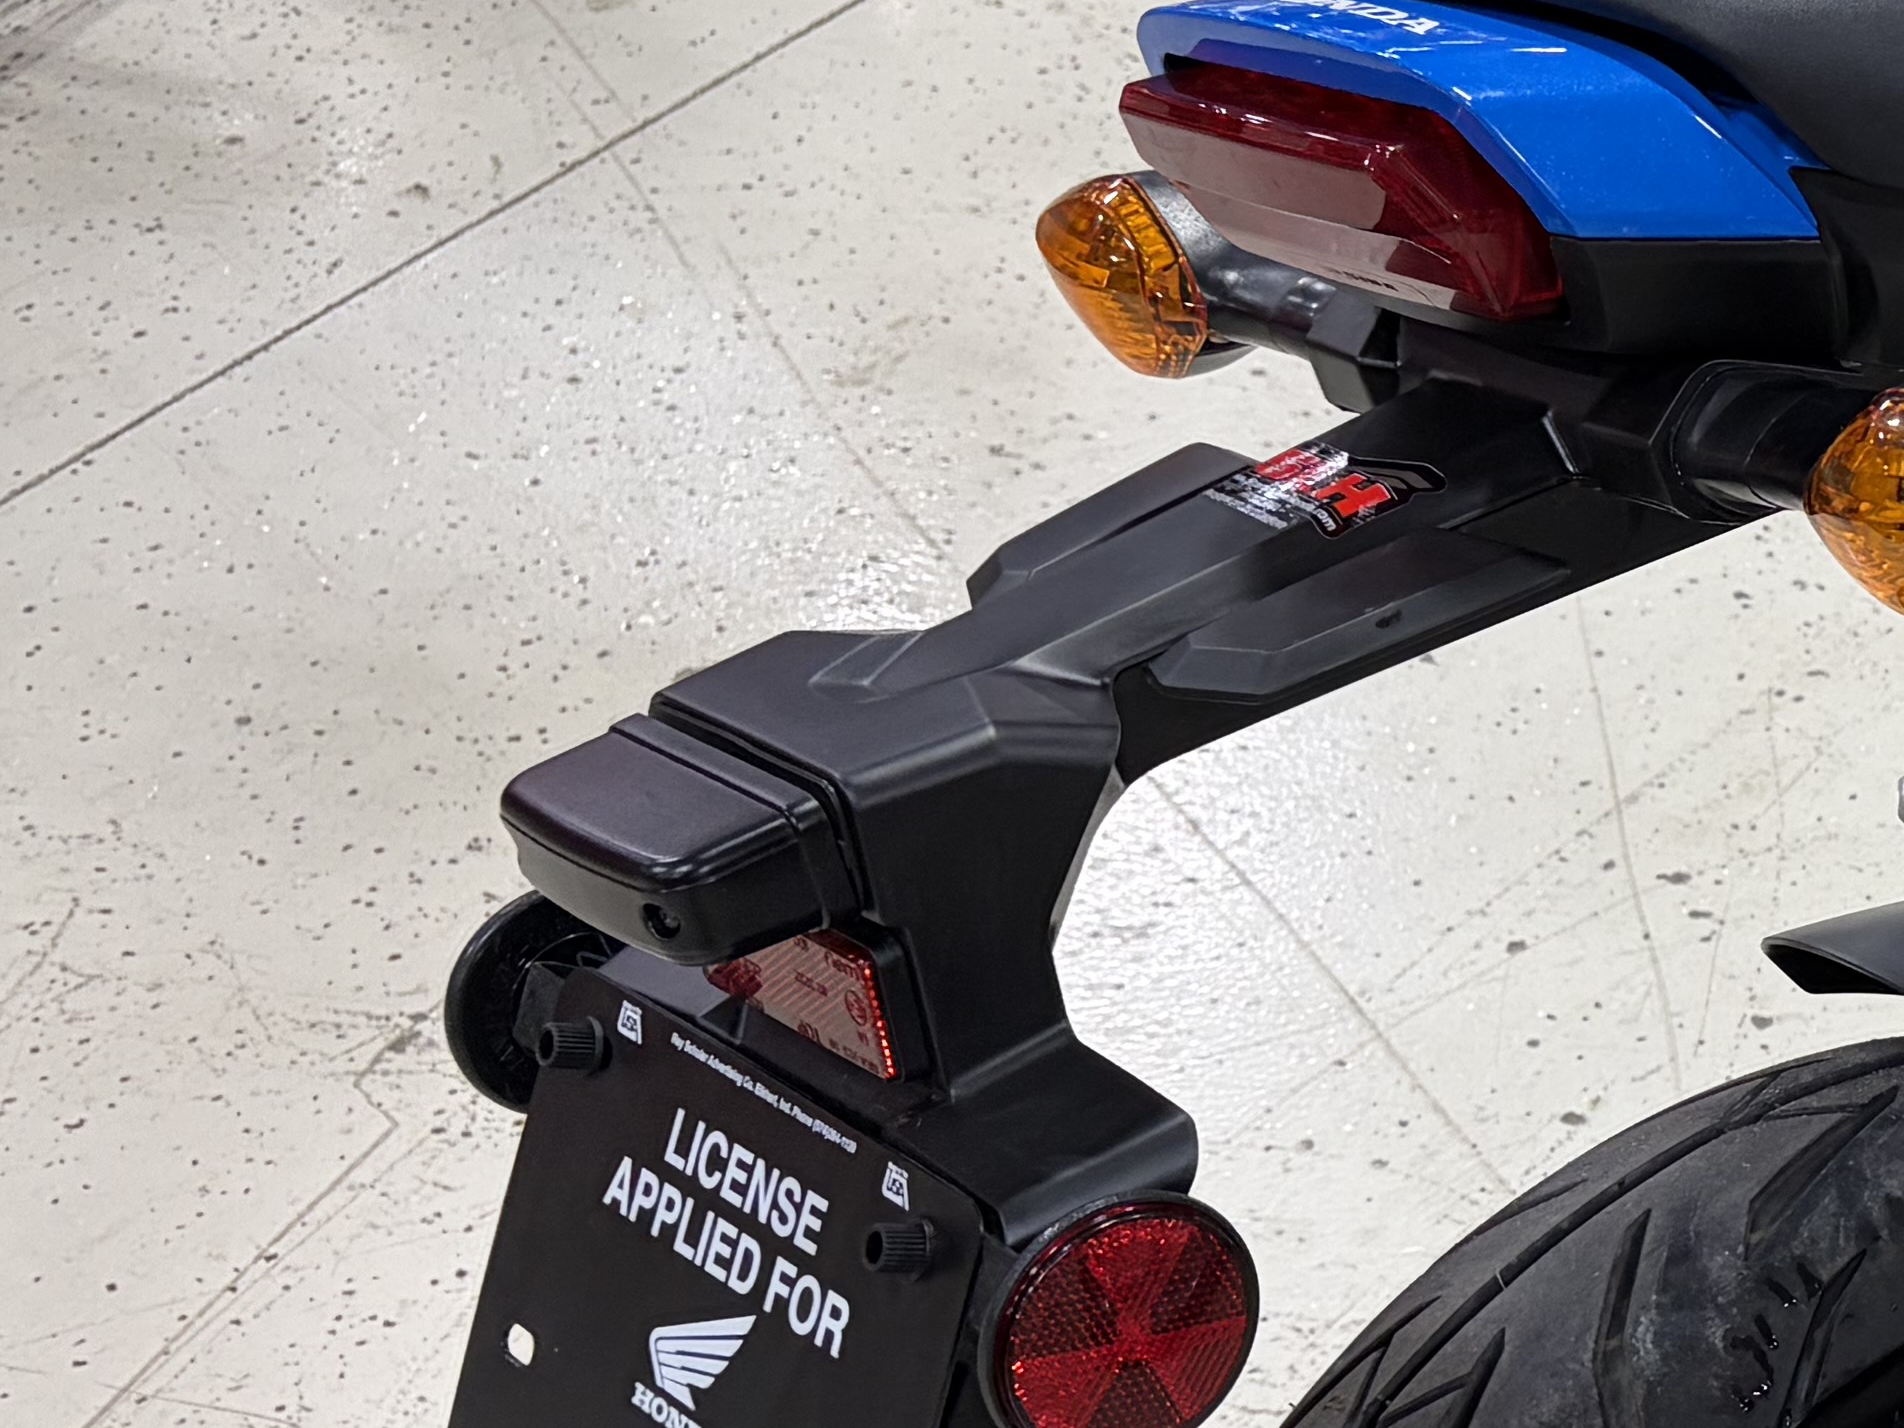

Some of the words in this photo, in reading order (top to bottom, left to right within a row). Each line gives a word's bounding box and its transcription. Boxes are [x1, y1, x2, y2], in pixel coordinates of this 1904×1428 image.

[602, 1155, 762, 1295] APPLIED
[762, 1255, 850, 1359] FOR
[663, 1107, 829, 1256] LICENSE
